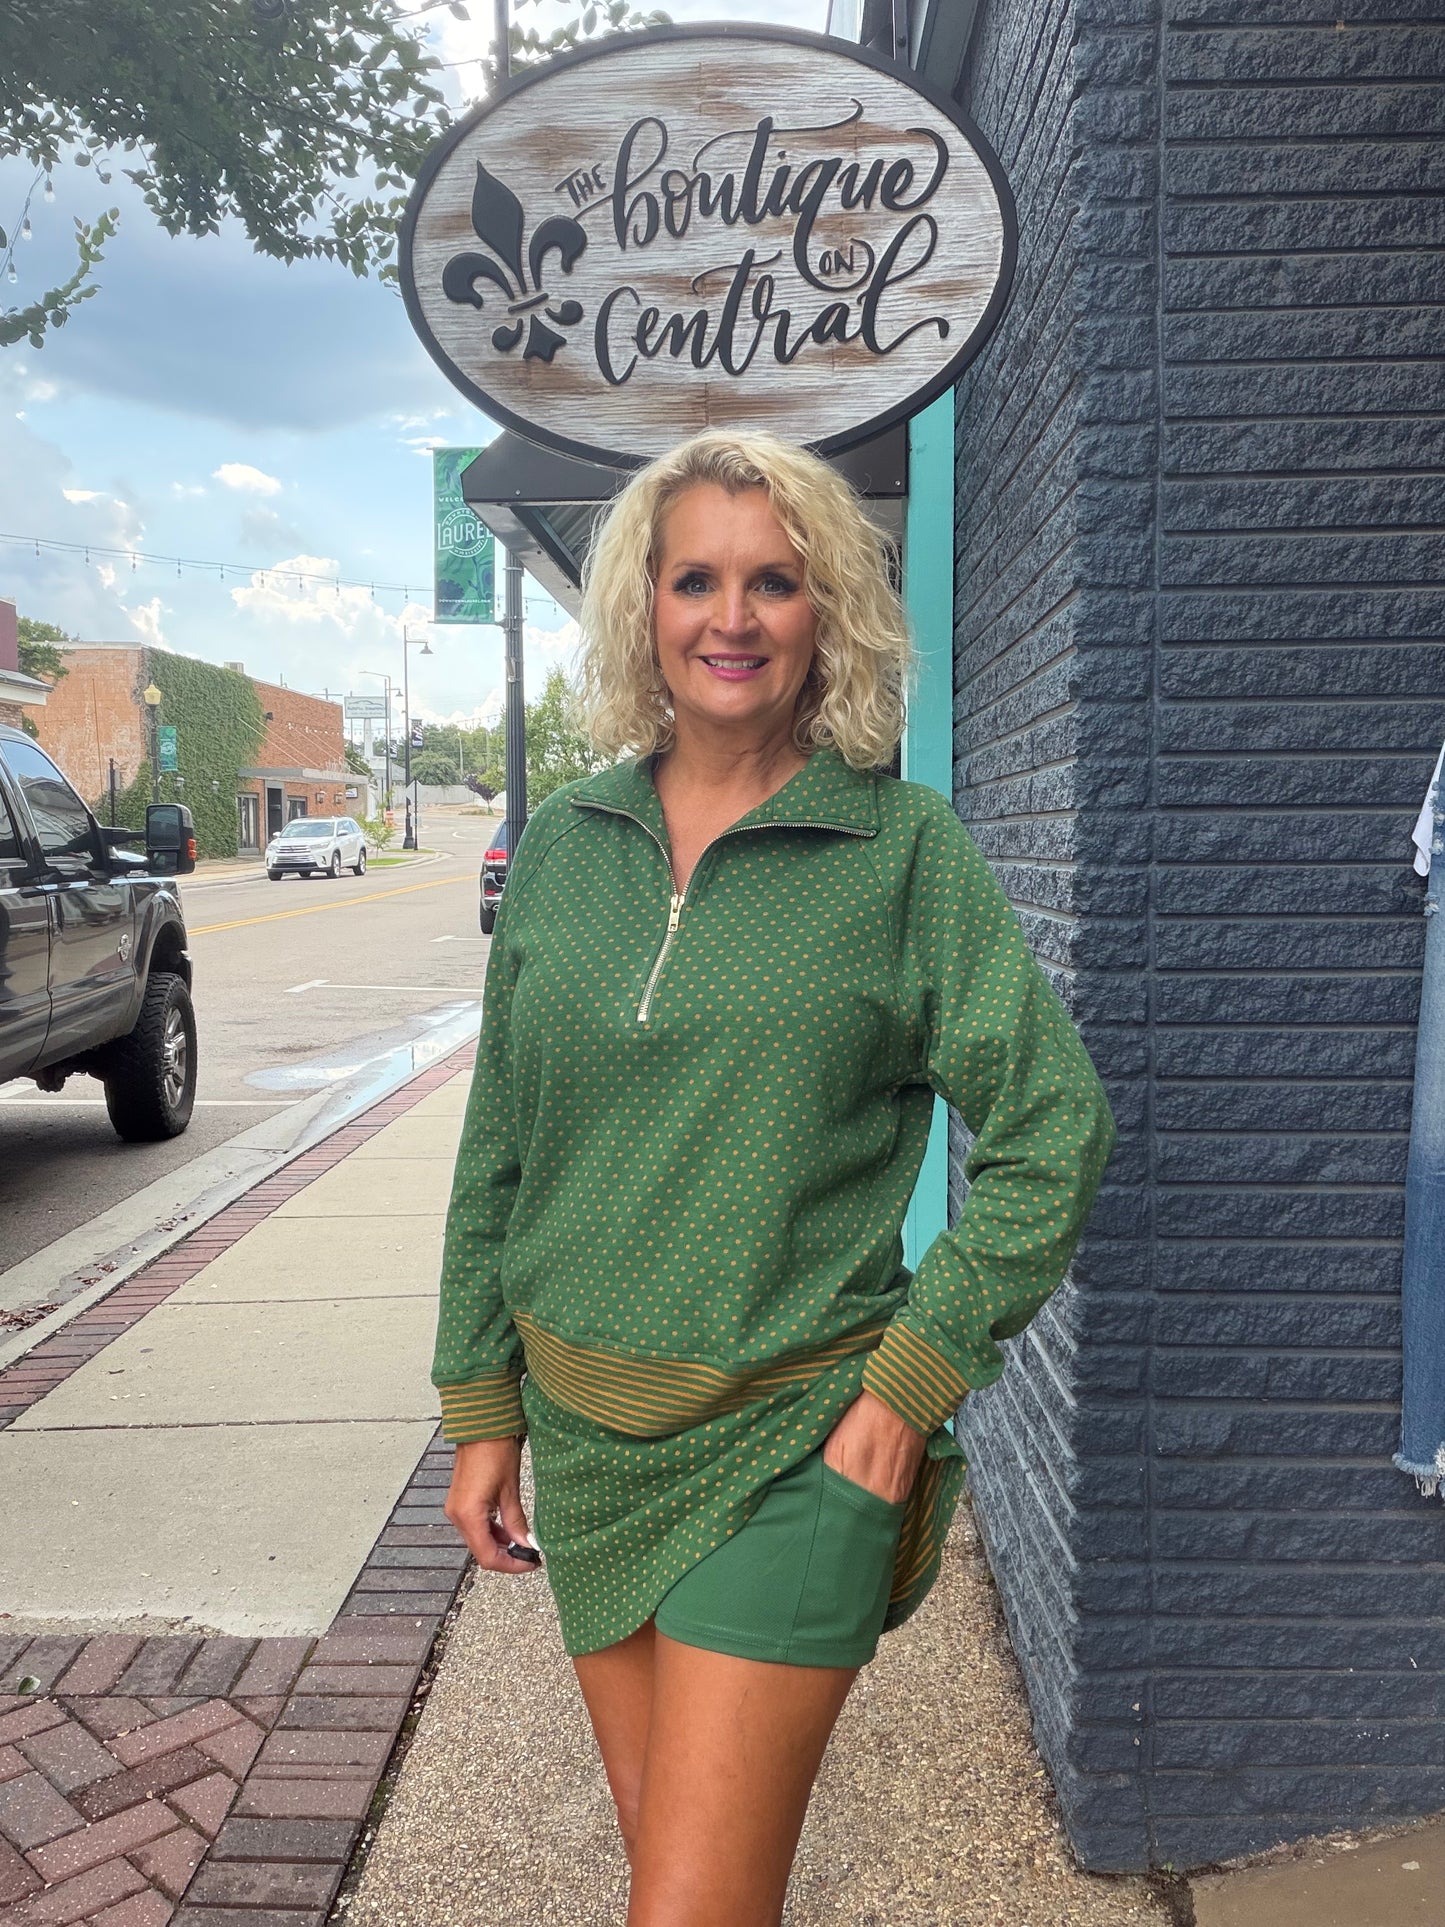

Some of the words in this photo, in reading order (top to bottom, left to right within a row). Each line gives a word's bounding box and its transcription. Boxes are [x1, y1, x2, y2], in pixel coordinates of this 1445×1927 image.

[555, 163, 608, 209] THE
[573, 98, 949, 292] boutique
[595, 214, 949, 385] Central
[817, 248, 856, 275] ON
